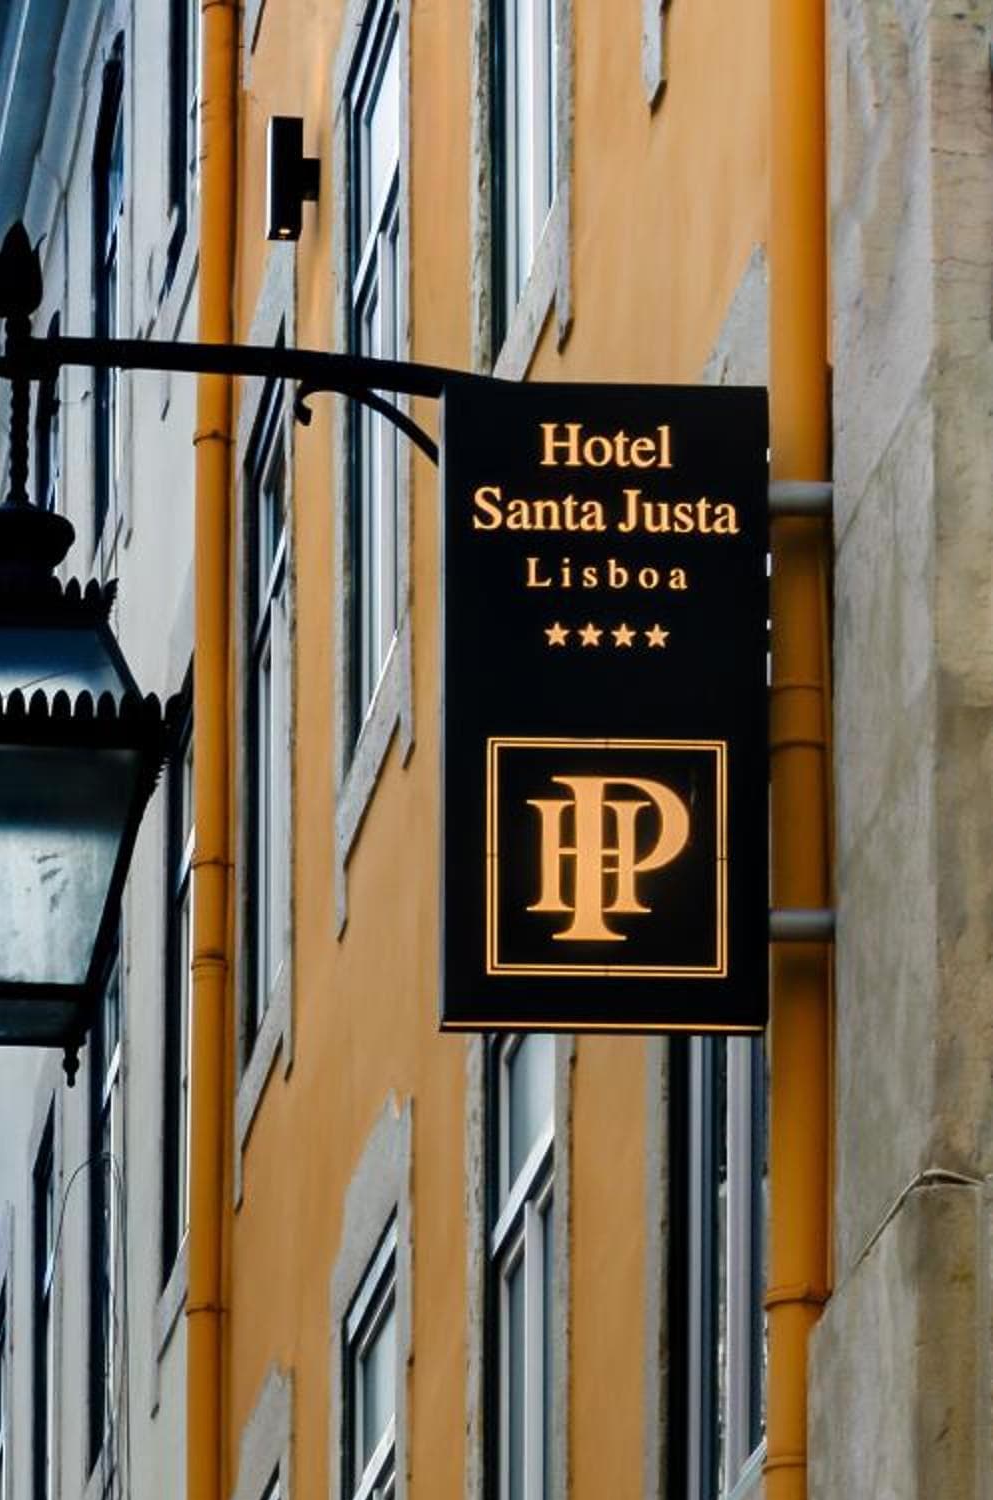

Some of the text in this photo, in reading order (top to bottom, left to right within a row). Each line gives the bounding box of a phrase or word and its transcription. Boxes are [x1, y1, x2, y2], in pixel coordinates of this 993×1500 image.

[540, 423, 672, 468] Hotel
[473, 486, 740, 535] Santa Justa
[526, 557, 688, 590] Lisboa
